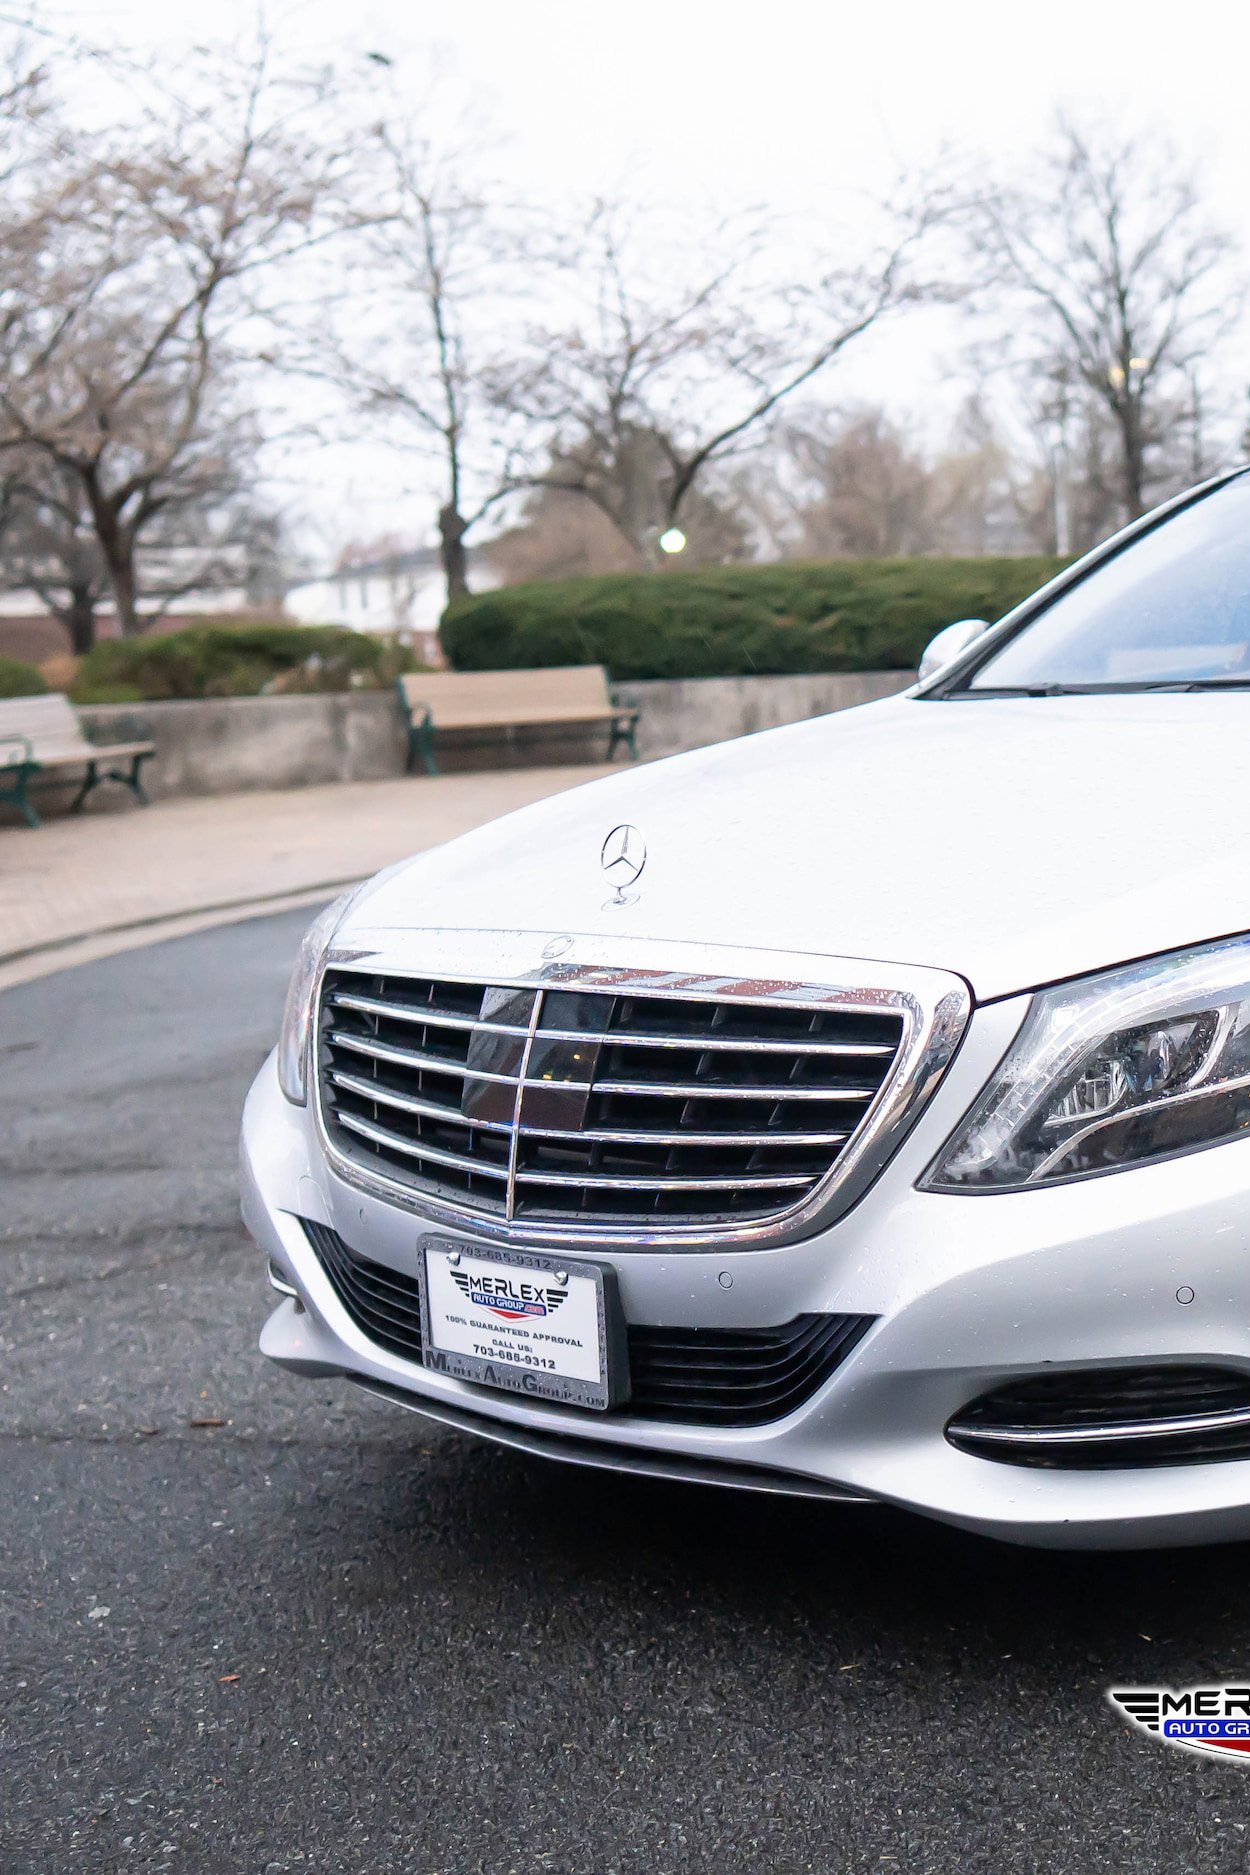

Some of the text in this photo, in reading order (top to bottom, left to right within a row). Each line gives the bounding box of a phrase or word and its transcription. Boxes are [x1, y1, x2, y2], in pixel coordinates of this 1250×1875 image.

[459, 1244, 551, 1269] 703-685-9312
[469, 1275, 546, 1304] MERLEX
[473, 1293, 496, 1305] AUTO
[445, 1315, 584, 1347] 100% GUARANTEED APPROVAL
[472, 1344, 556, 1369] 703-685-9312
[491, 1338, 533, 1353] CALL US:
